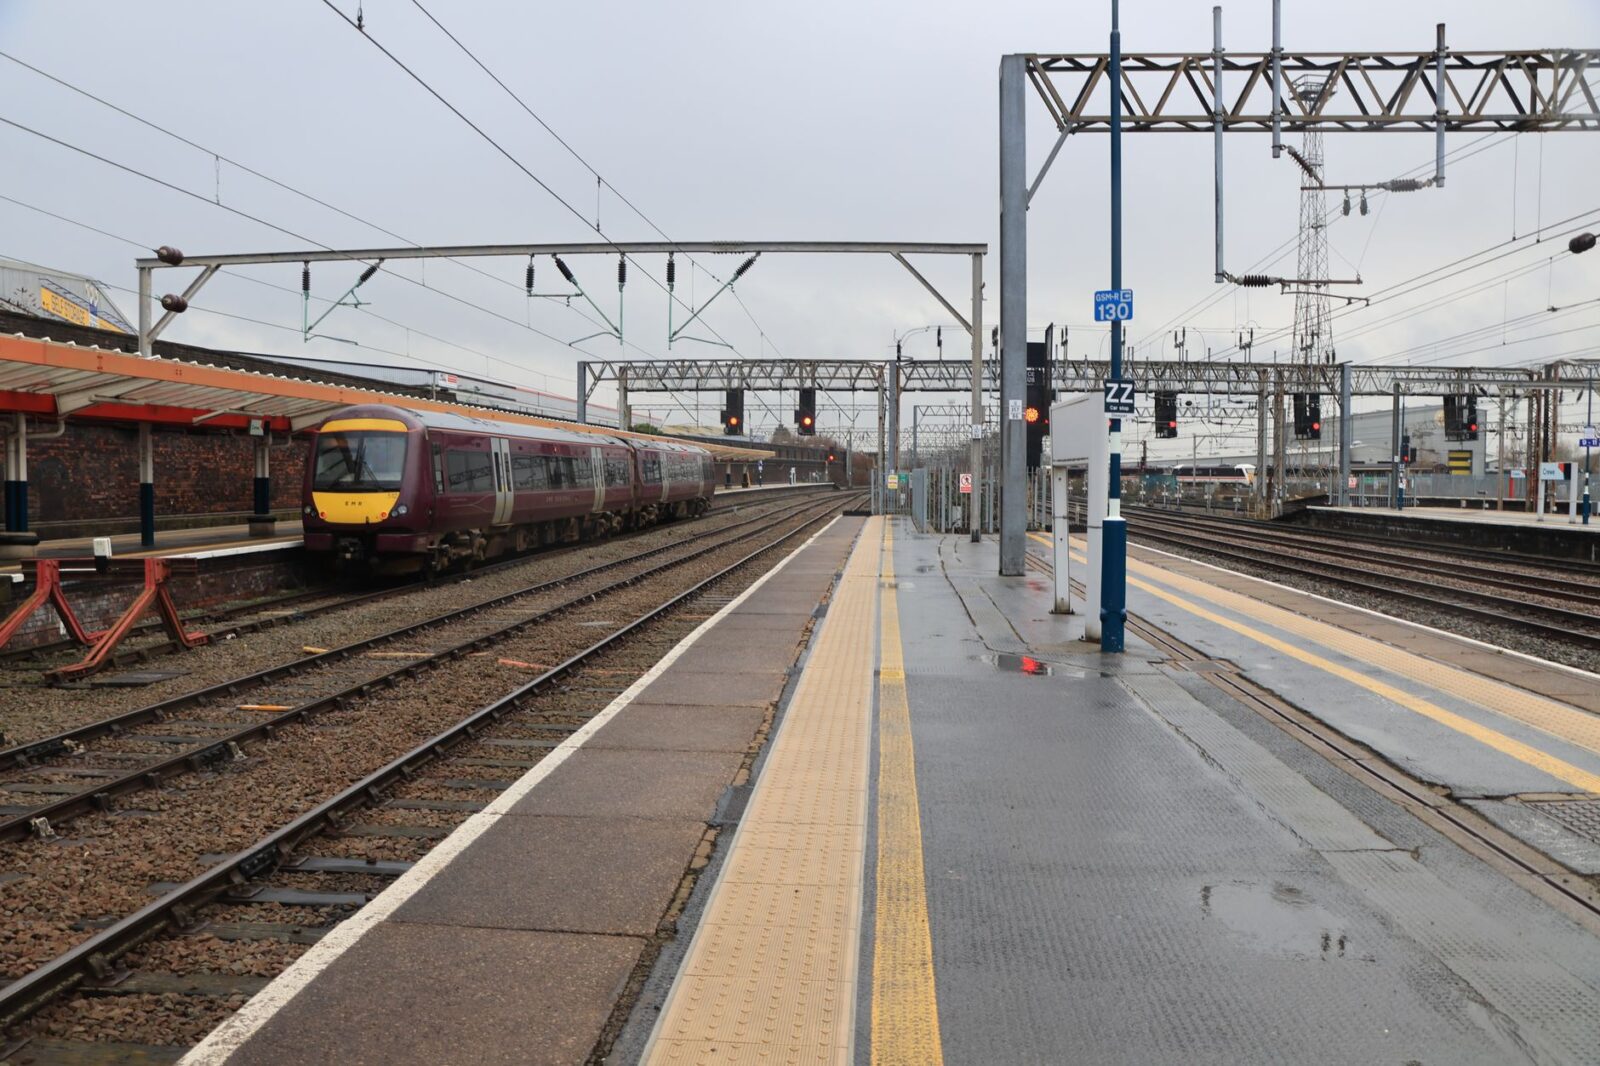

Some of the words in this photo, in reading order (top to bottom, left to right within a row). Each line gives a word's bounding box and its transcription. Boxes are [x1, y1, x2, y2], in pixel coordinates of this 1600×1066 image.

[1095, 293, 1119, 302] GSM-R
[1098, 303, 1129, 320] 130
[1106, 383, 1133, 403] ZZ
